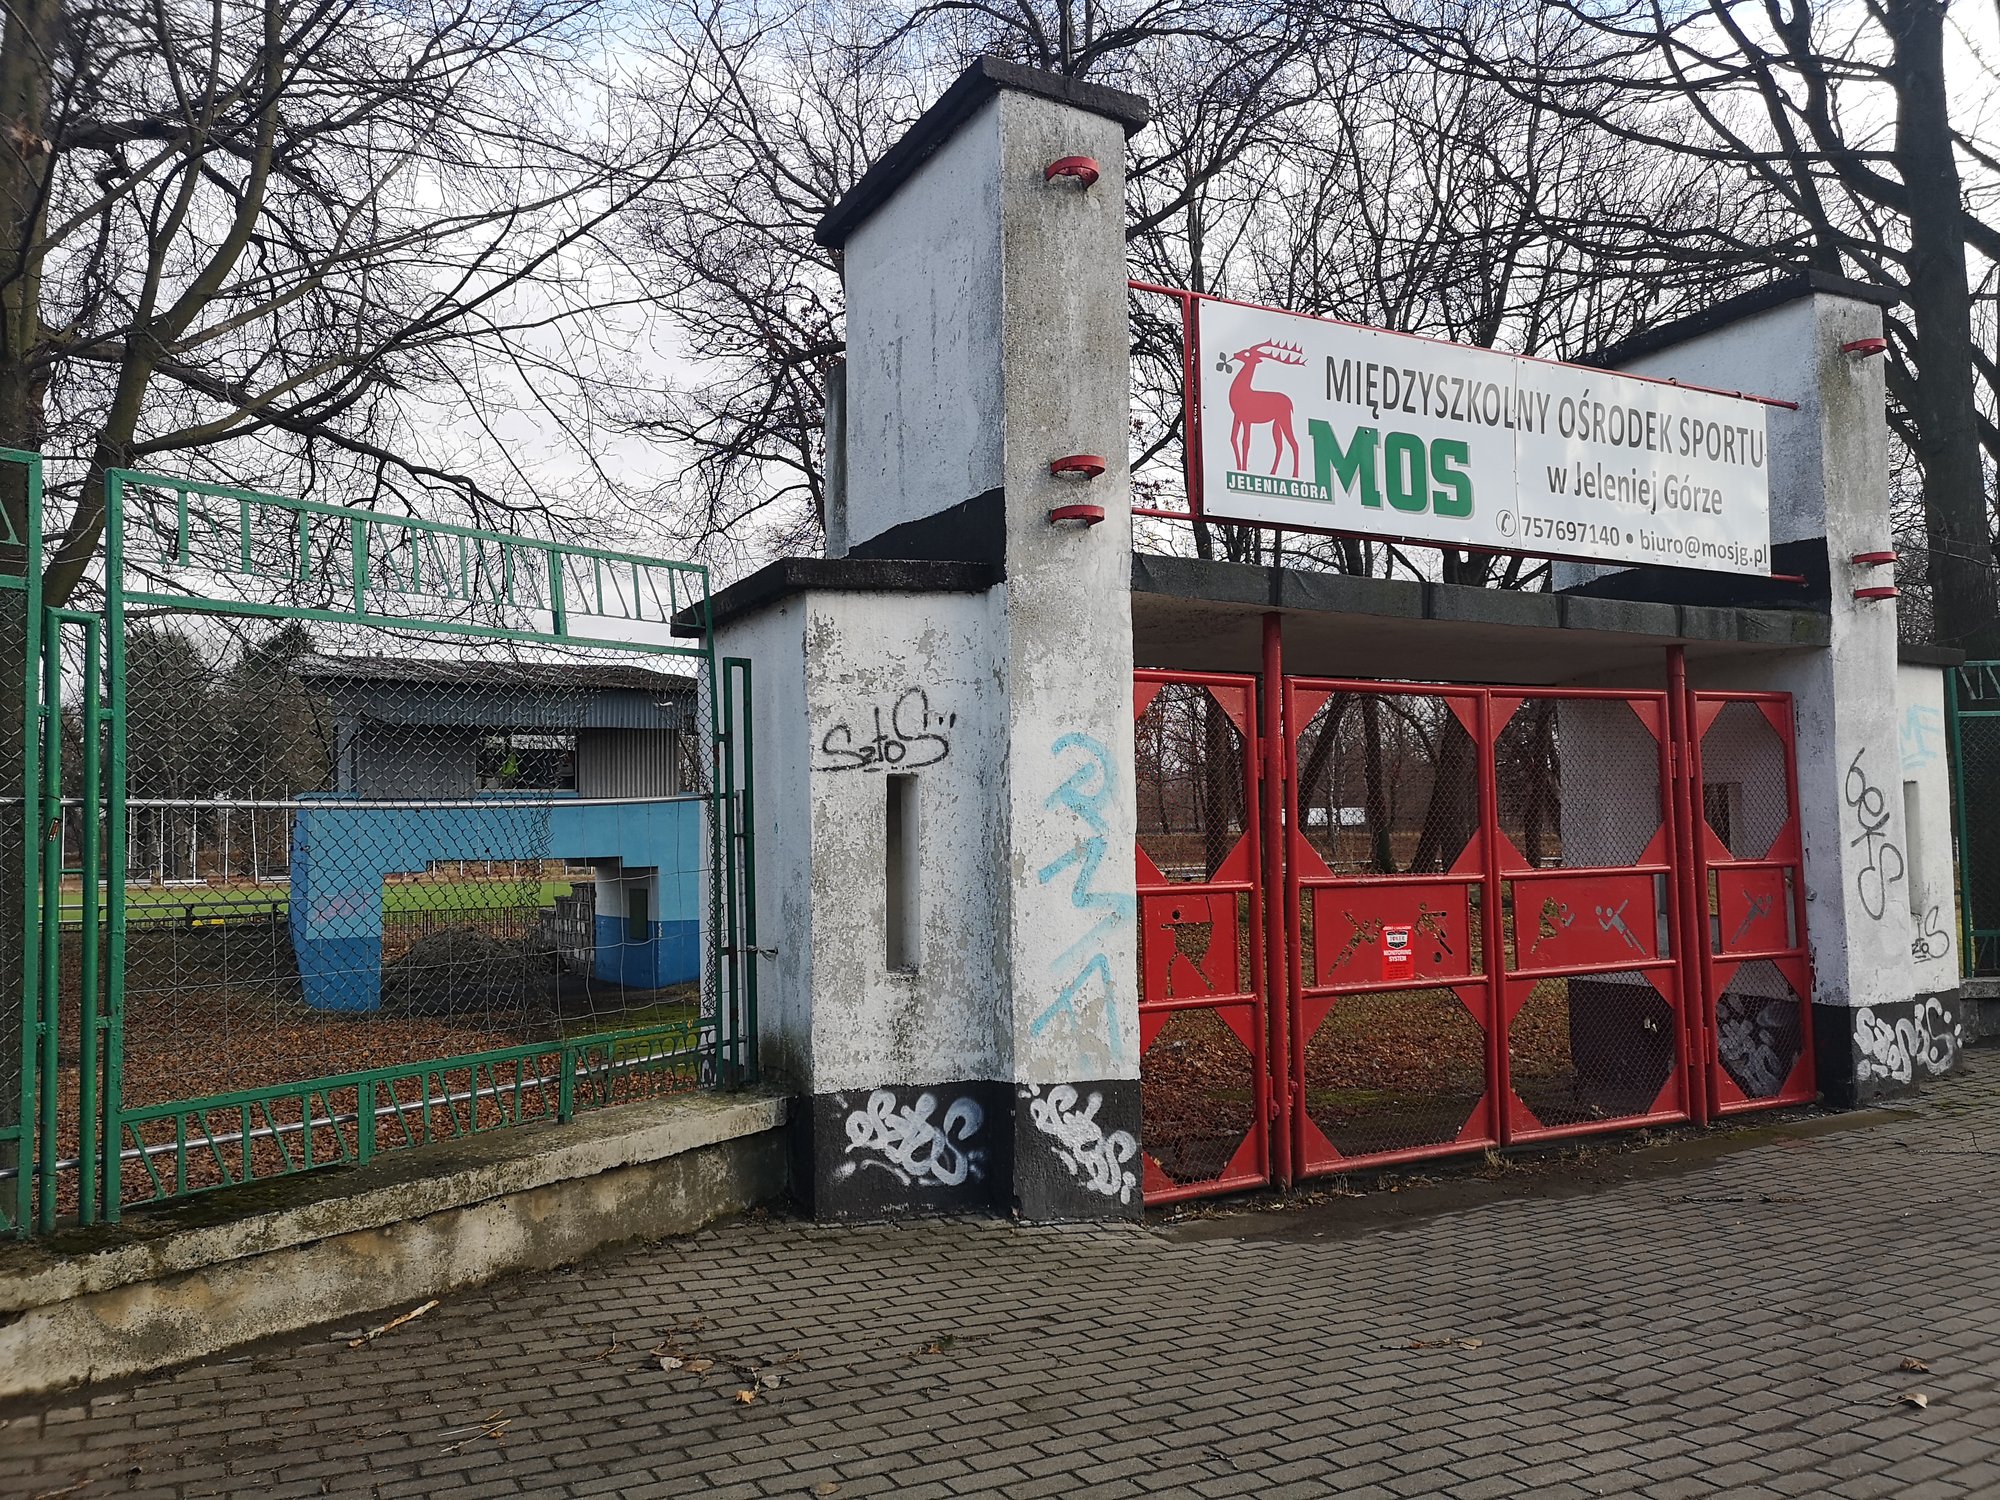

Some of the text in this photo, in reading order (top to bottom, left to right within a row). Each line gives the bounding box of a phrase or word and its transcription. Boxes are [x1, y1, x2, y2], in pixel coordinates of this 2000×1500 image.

[1326, 355, 1763, 469] MIĘDZYSZKOLNY OŚRODEK SPORTU
[1228, 473, 1329, 500] JELENIA GÓRA
[1308, 418, 1473, 518] MOS
[1546, 461, 1723, 516] w Jeleniej Górze
[1521, 515, 1768, 568] 757697140 biuro@mosjg.pl
